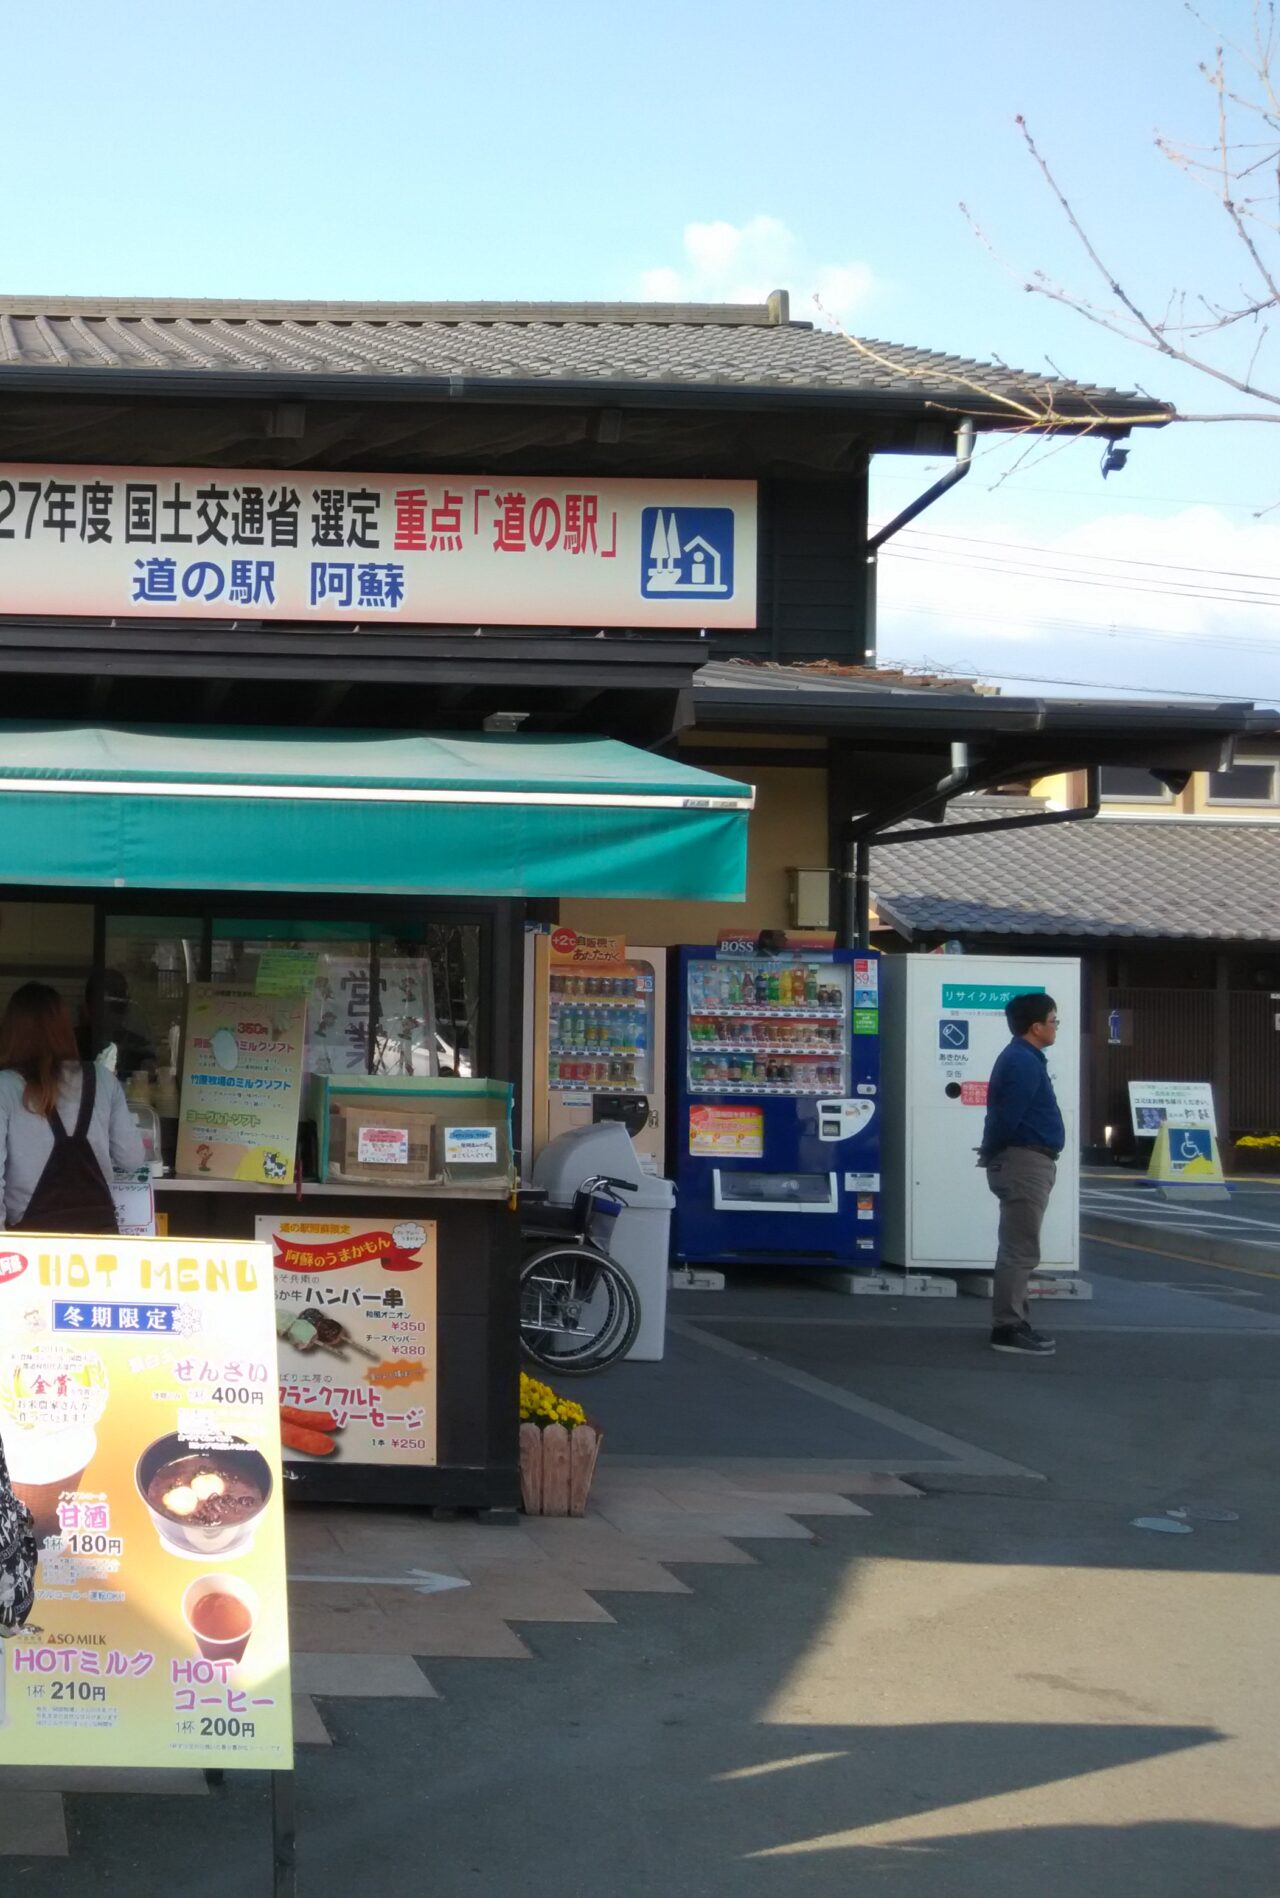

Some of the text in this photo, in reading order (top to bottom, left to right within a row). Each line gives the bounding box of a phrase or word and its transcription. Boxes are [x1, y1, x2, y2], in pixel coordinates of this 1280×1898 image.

[124, 483, 302, 549] 国土交通省
[311, 487, 381, 550] 選定
[393, 488, 618, 558] 重点「道の駅」
[131, 557, 406, 608] 道の駅 阿蘇
[721, 941, 754, 952] BOSS
[285, 1237, 392, 1268] 阿蘇のうまかもん
[37, 1253, 259, 1292] HOT MENU
[63, 1305, 167, 1331] 冬期限定
[391, 1321, 426, 1332] ¥350
[391, 1346, 426, 1356] ¥380
[211, 1386, 264, 1405] 400円
[331, 1408, 425, 1430] ソーセージ
[391, 1438, 426, 1450] ¥250
[59, 1504, 108, 1529] 甘酒
[68, 1534, 122, 1554] 180円
[47, 1633, 74, 1645] ASO
[77, 1633, 107, 1646] MILK
[13, 1648, 155, 1677] HOTミルク
[171, 1660, 234, 1685] HOT
[26, 1680, 107, 1702] 1杯 210円
[174, 1689, 275, 1713] コーヒー
[175, 1717, 255, 1738] 1杯 200円
